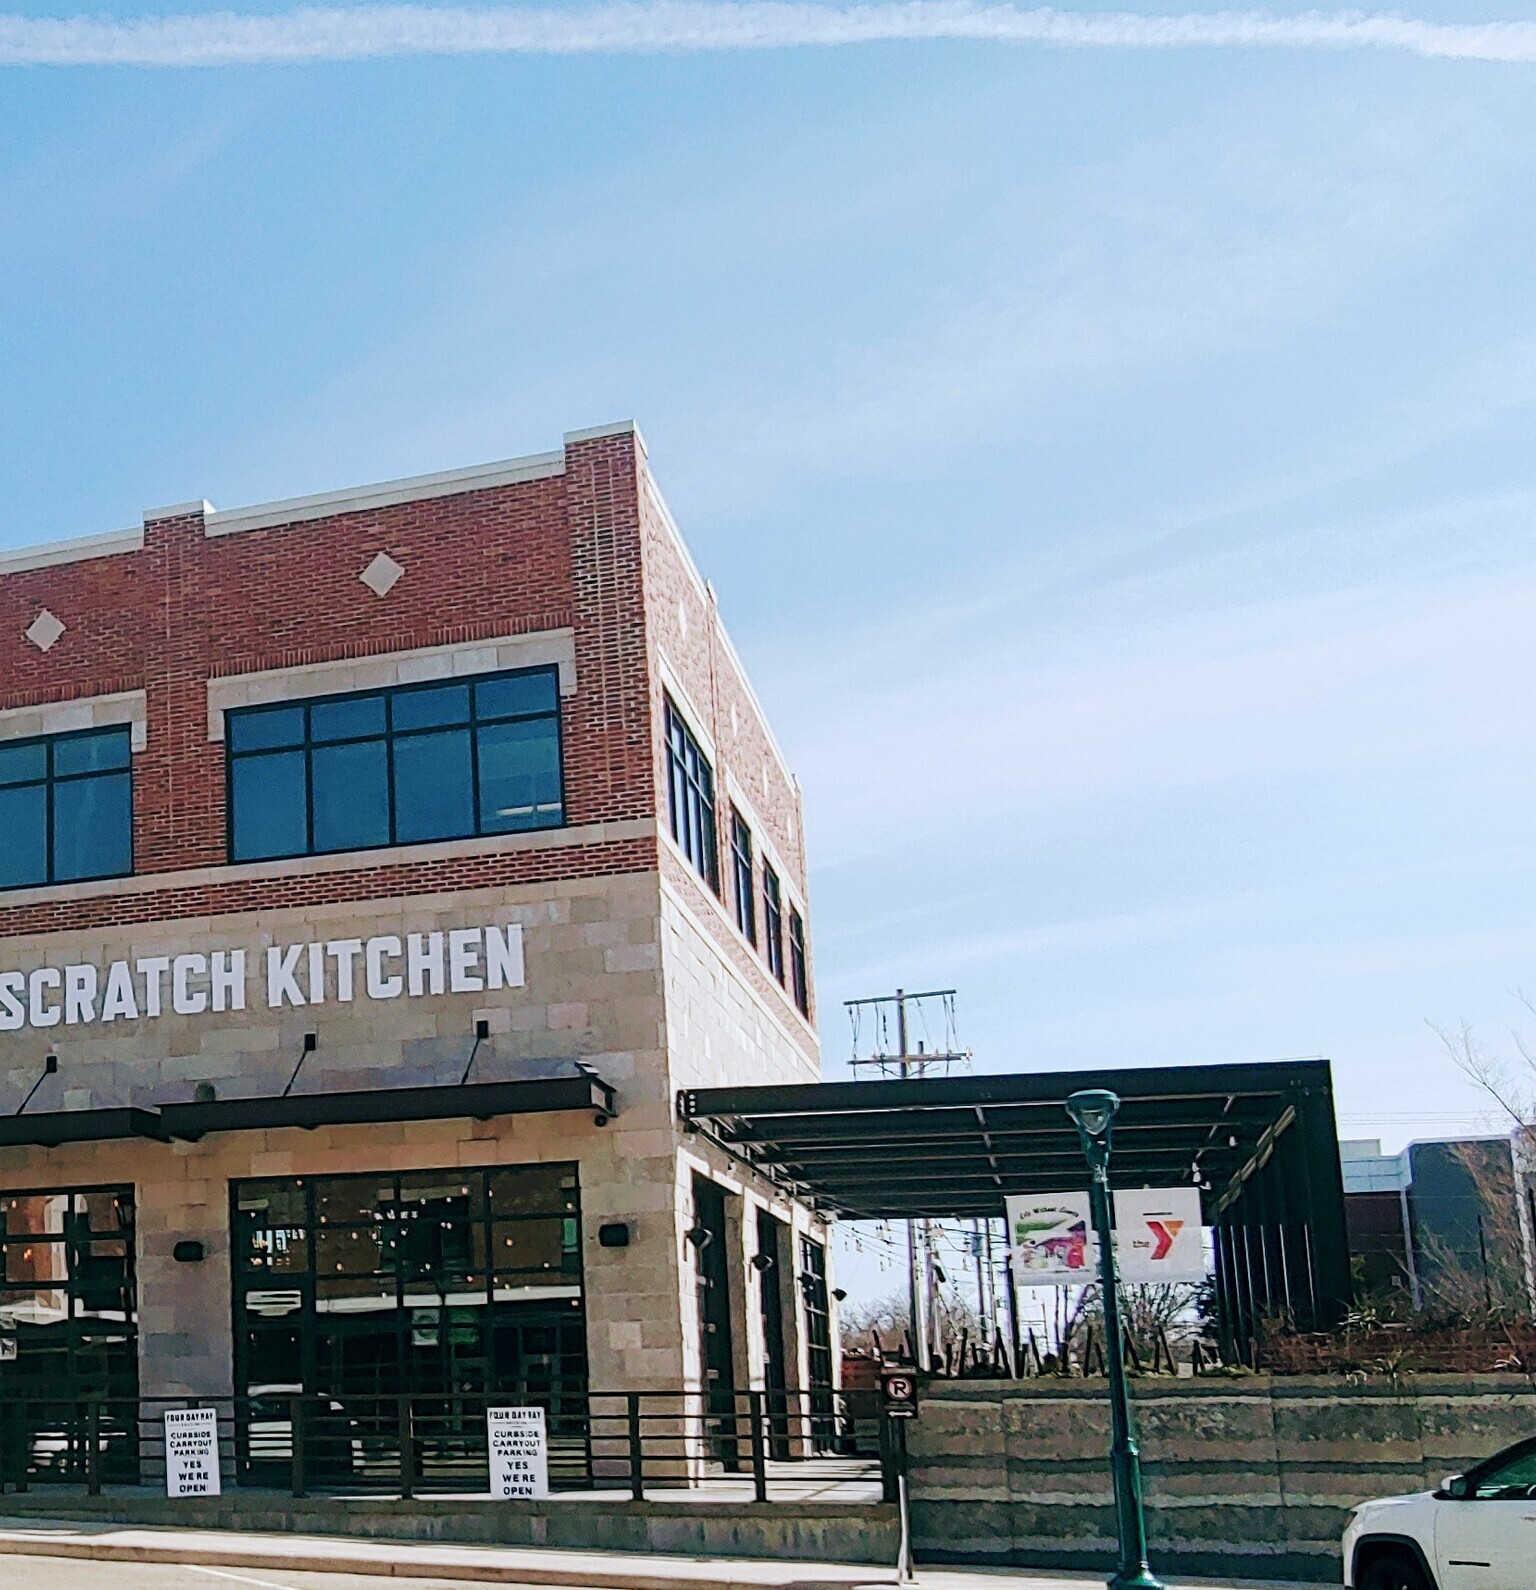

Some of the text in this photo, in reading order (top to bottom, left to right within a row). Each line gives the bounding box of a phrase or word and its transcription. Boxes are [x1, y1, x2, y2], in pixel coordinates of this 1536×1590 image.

[266, 923, 526, 1008] KITCHEN
[166, 1412, 213, 1422] FOUR DAY RAY
[489, 1411, 510, 1419] FOUR
[511, 1411, 526, 1419] DAY
[170, 1431, 211, 1439] CURBSIDE
[169, 1440, 212, 1448] CARRYOUT
[173, 1449, 209, 1457] PARKING
[497, 1449, 538, 1457] PARKING
